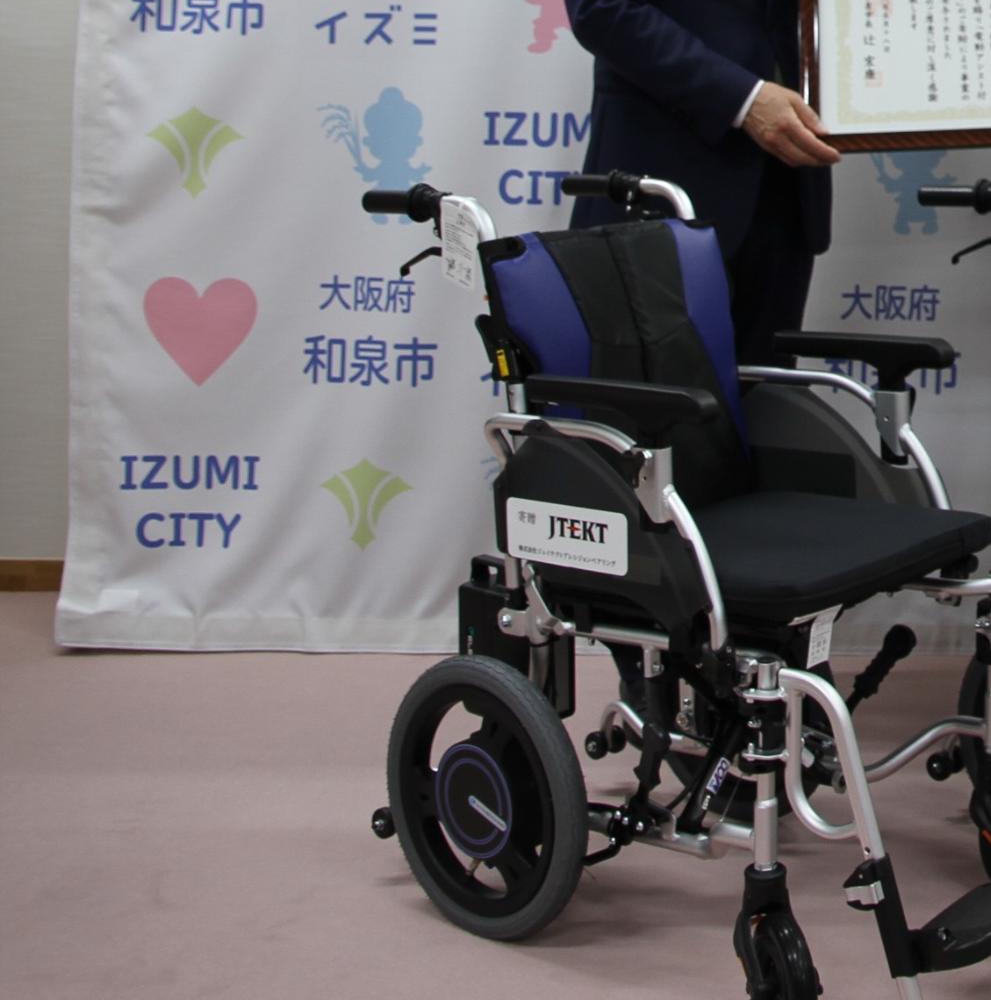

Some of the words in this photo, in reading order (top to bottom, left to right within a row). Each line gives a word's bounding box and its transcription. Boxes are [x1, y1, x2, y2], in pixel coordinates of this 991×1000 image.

[315, 5, 437, 45] イズミ
[483, 111, 592, 148] IZUM
[498, 169, 582, 206] CIT
[319, 274, 416, 314] 大阪府
[841, 285, 939, 321] 大阪府
[304, 335, 438, 387] 和泉市
[120, 455, 259, 490] IZUMI
[136, 513, 241, 548] CITY
[548, 515, 609, 544] JTEKT
